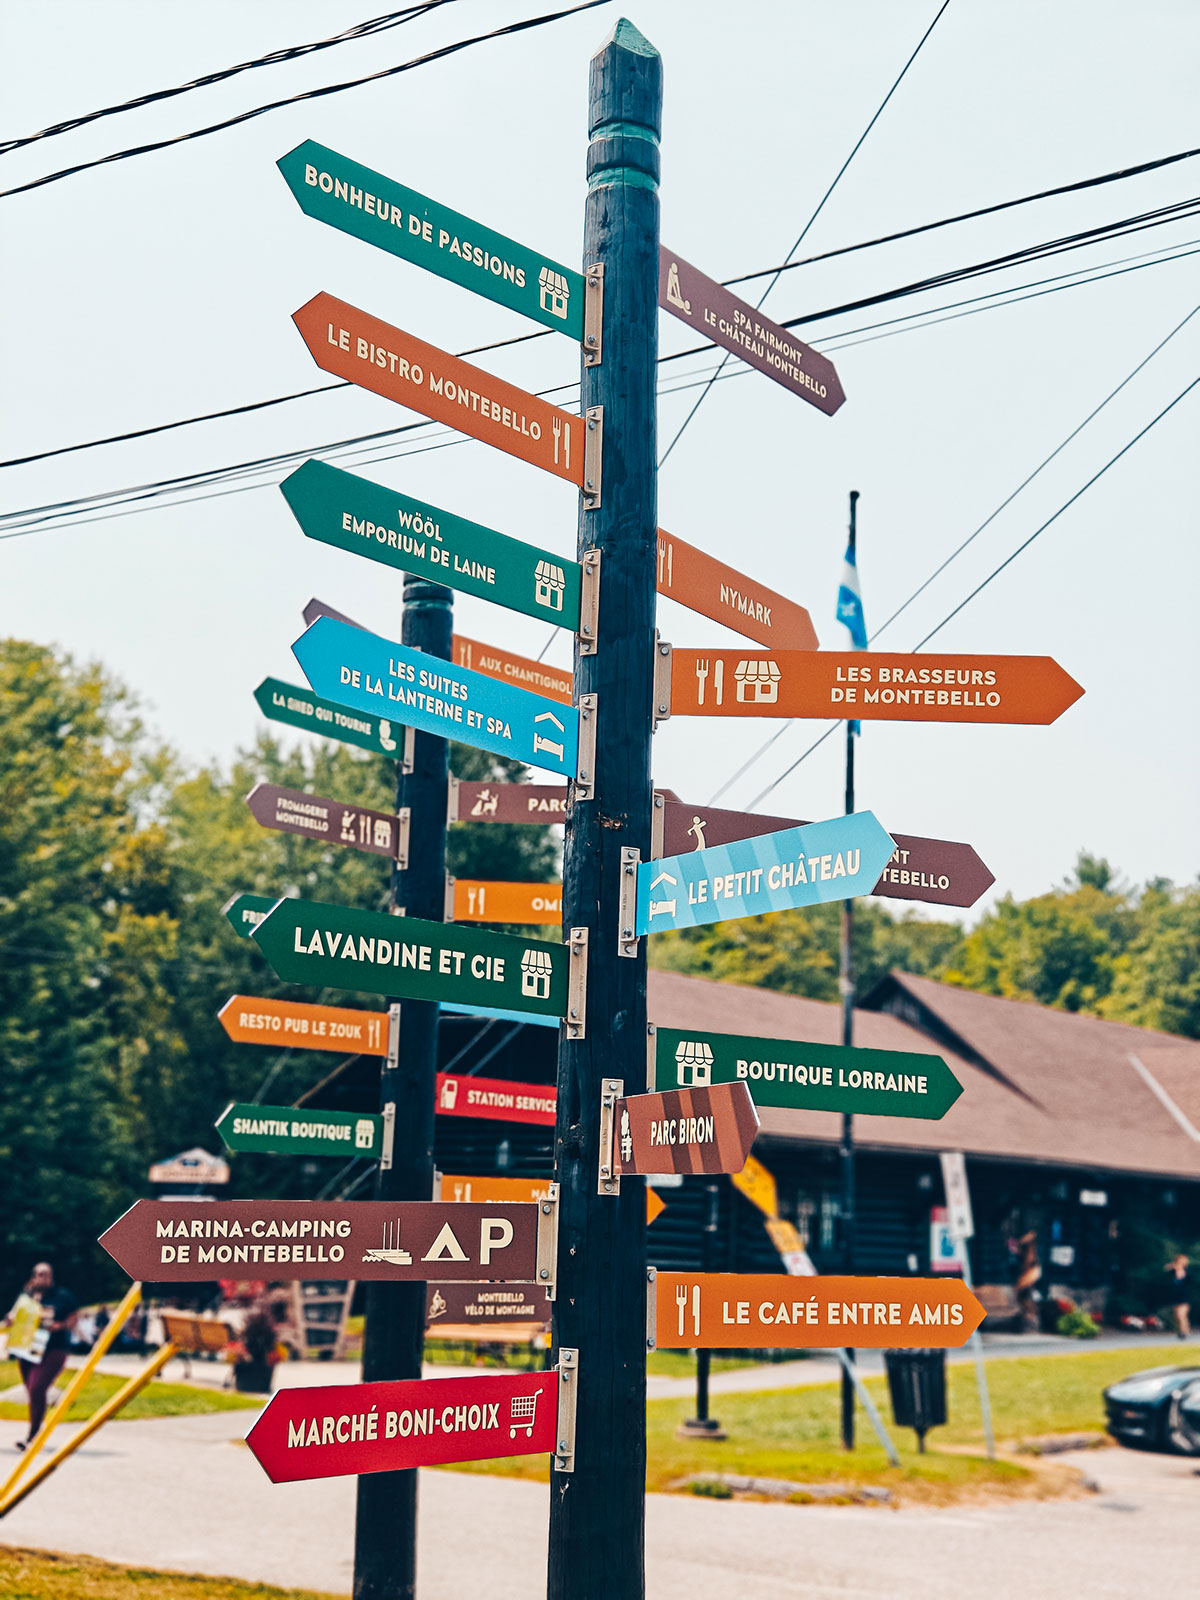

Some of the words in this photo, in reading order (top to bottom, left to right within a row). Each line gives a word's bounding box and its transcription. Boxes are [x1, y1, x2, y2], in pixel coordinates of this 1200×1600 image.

[304, 163, 402, 229] BONHEUR
[408, 214, 432, 243] DE
[439, 229, 526, 288] PASSIONS
[704, 308, 716, 327] LE
[720, 320, 764, 358] CHÂTEAU
[766, 351, 827, 398] MONTEBELLO
[734, 310, 752, 332] SPA
[755, 323, 802, 365] FAIRMONT
[328, 323, 350, 352] LE
[357, 338, 423, 385] BISTRO
[429, 371, 541, 441] MONTEBELLO
[398, 510, 443, 542] WÖÖL
[342, 512, 425, 559] EMPORIUM
[430, 546, 449, 567] DE
[454, 554, 496, 585] LAINE
[720, 583, 772, 627] NYMARK
[389, 658, 415, 682] LES
[419, 670, 468, 701] SUITES
[480, 656, 501, 672] AUX
[836, 666, 872, 683] LES
[879, 667, 996, 686] BRASSEURS
[340, 666, 360, 688] DE
[366, 674, 384, 696] LA
[388, 682, 462, 724] LANTERNE
[467, 705, 484, 729] ET
[487, 716, 512, 739] SPA
[831, 688, 857, 704] DE
[864, 689, 1000, 706] MONTEBELLO
[273, 692, 286, 707] LA
[316, 707, 333, 722] QUI
[335, 712, 371, 735] TOURNE
[276, 811, 329, 832] MONTEBELLO
[277, 798, 328, 819] FROMAGERIE
[688, 882, 707, 905] LE
[713, 868, 763, 900] PETIT
[768, 849, 861, 890] CHÂTEAU
[294, 927, 432, 971] LAVANDINE
[439, 949, 466, 976] ET
[471, 954, 505, 982] CIE
[240, 1013, 282, 1032] RESTO
[284, 1018, 308, 1034] PUB
[312, 1021, 326, 1036] LE
[330, 1022, 362, 1039] ZOUK
[736, 1060, 832, 1086] BOUTIQUE
[839, 1069, 928, 1094] LORRAINE
[467, 1090, 514, 1108] STATION
[232, 1118, 287, 1137] SHANTIK
[291, 1122, 351, 1141] BOUTIQUE
[650, 1120, 676, 1146] PARC
[680, 1116, 714, 1144] BIRON
[156, 1220, 351, 1238] MARINA-CAMPING
[480, 1218, 514, 1265] P
[161, 1246, 190, 1264] DE
[198, 1246, 344, 1263] MONTEBELLO
[465, 1304, 484, 1315] VÉLO
[485, 1305, 494, 1315] DE
[496, 1305, 534, 1315] MONTAGNE
[478, 1293, 524, 1302] MONTEBELLO
[723, 1302, 750, 1324] LE
[758, 1296, 819, 1324] CAFÉ
[828, 1303, 902, 1325] ENTRE
[908, 1304, 964, 1326] AMIS
[288, 1404, 378, 1448] MARCHÉ
[386, 1403, 500, 1438] BONI-CHOIX
